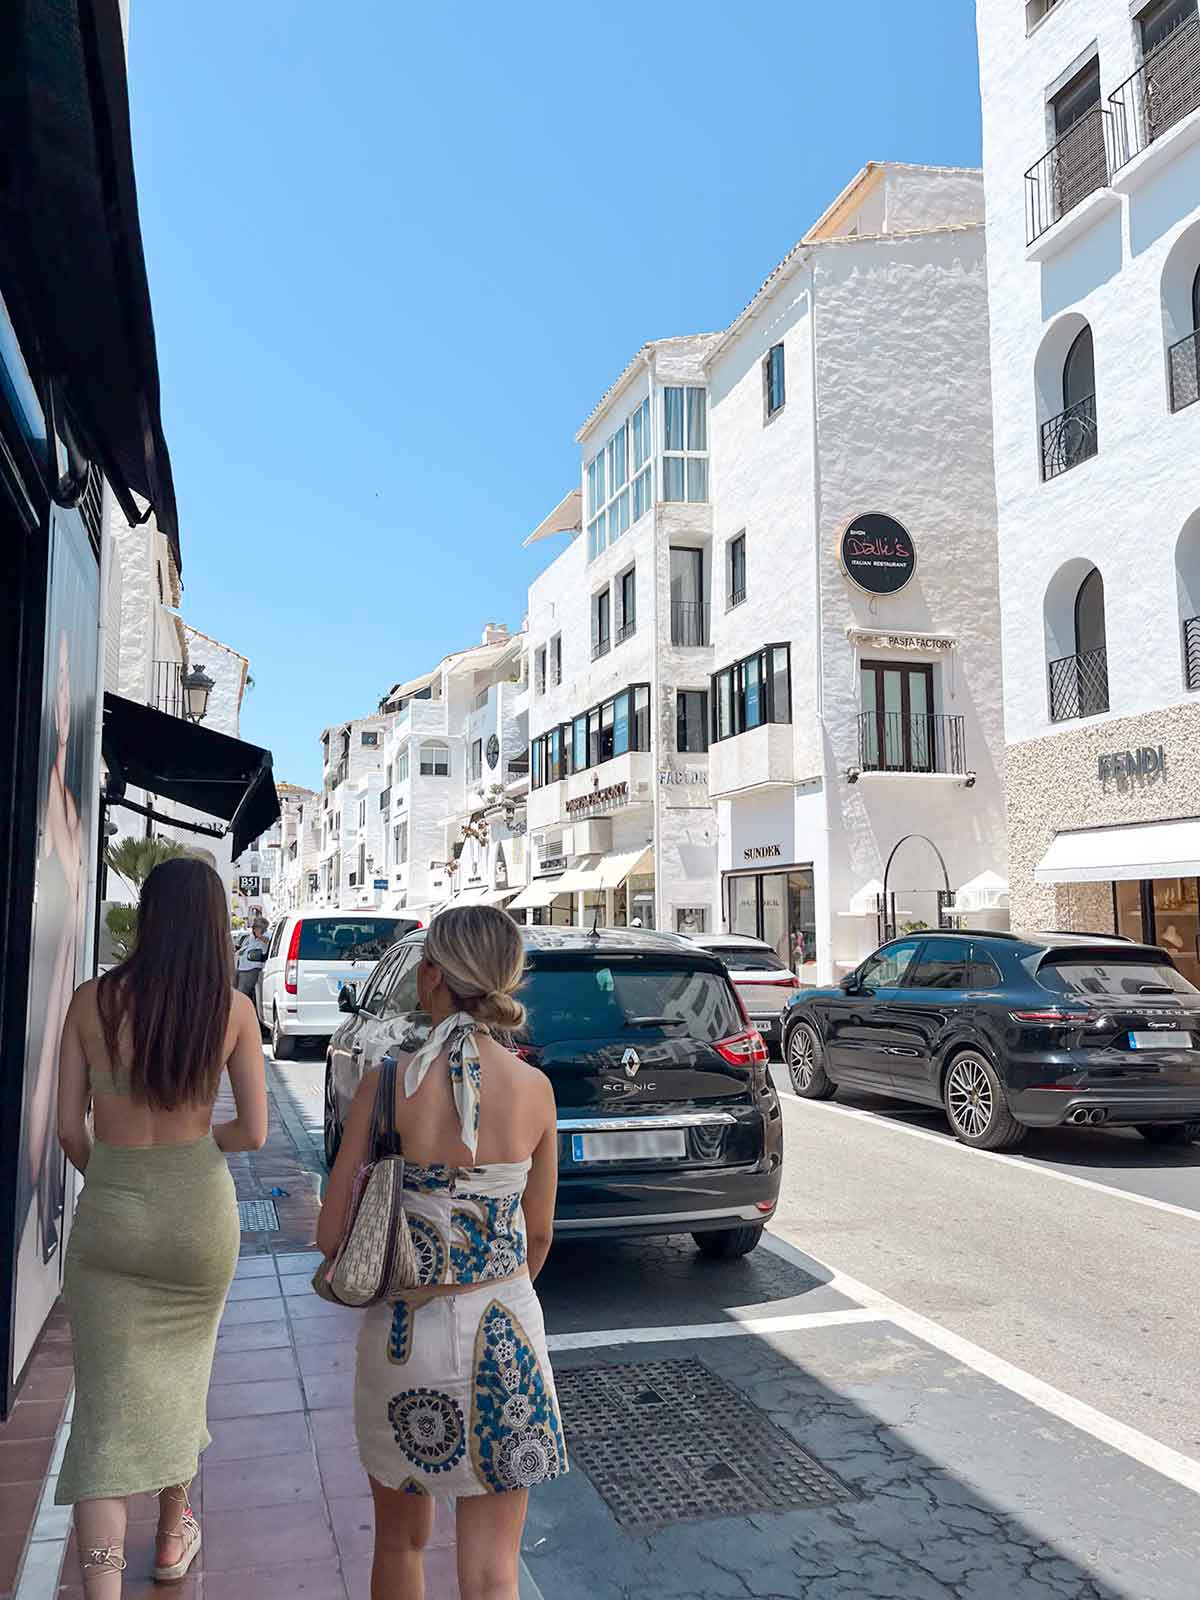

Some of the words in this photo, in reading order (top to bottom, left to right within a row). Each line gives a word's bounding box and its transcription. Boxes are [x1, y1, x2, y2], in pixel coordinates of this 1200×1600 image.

[888, 637, 914, 647] PASTA
[916, 638, 953, 649] FACTORY
[1098, 744, 1164, 781] FENDI
[744, 844, 781, 860] SUNDEK
[602, 1082, 657, 1091] SCENIC
